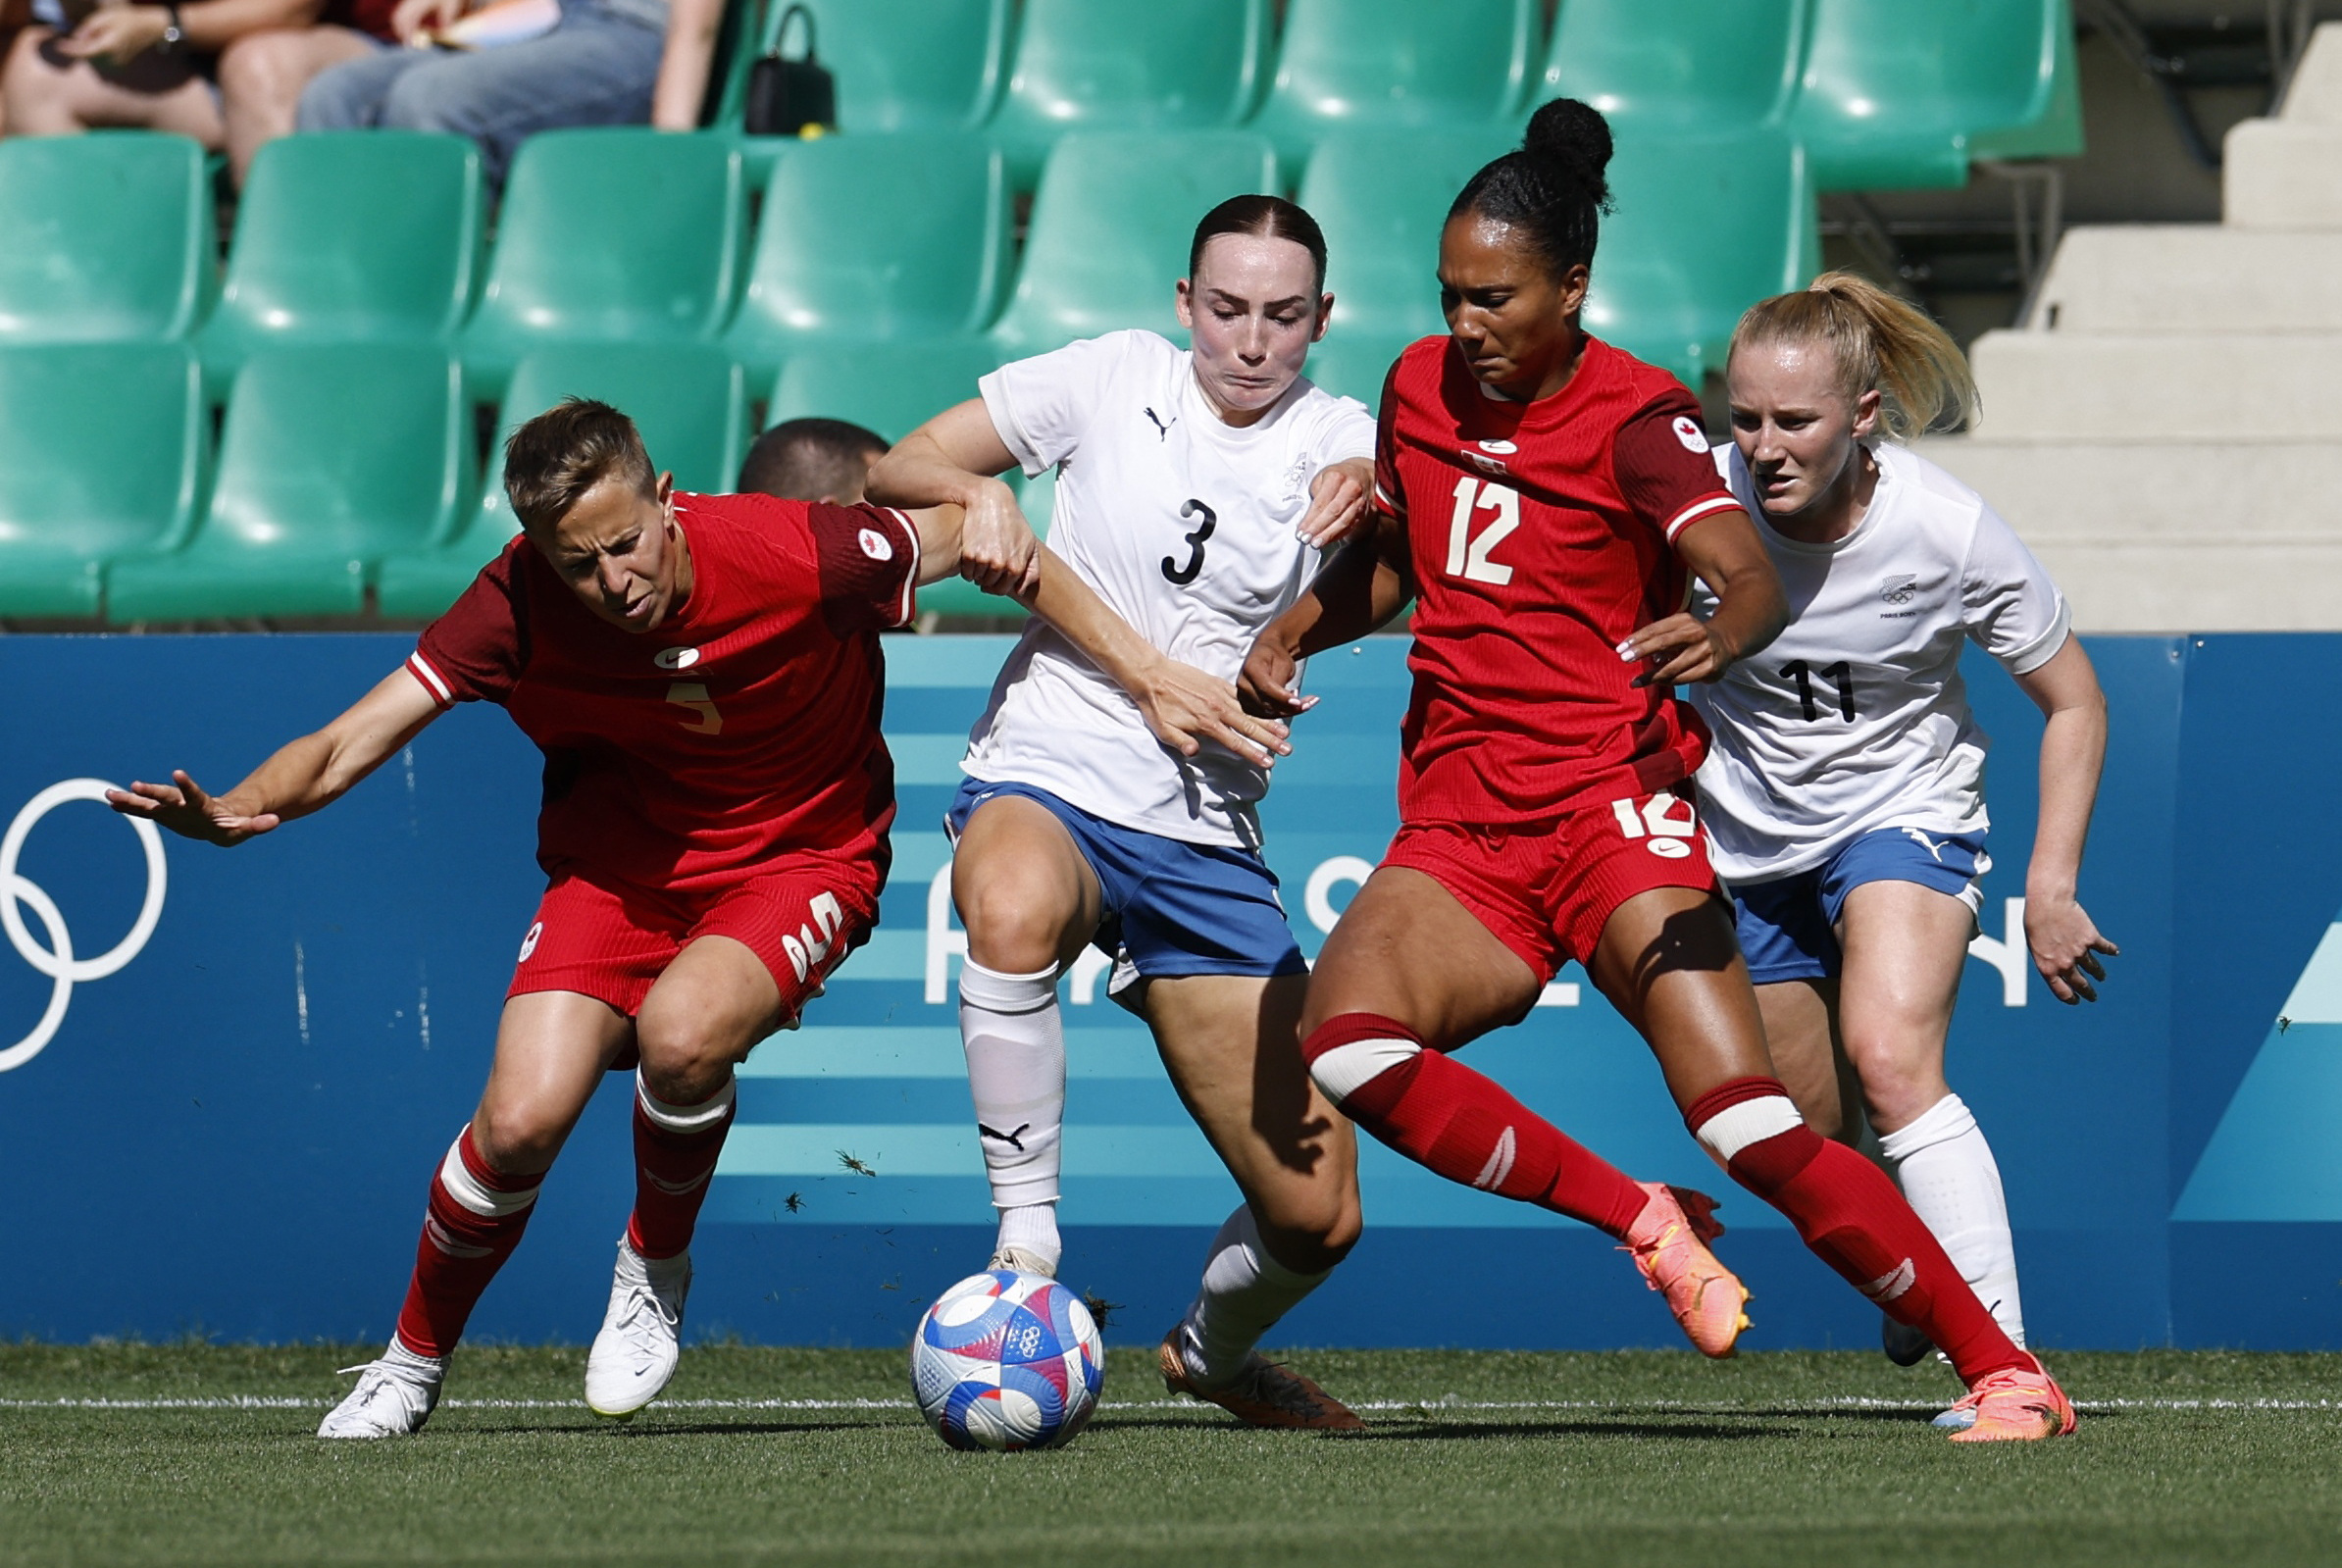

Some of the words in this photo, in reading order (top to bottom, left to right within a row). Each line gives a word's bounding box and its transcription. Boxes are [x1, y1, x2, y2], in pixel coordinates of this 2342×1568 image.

[1161, 499, 1217, 584] 3
[1446, 477, 1519, 585] 12
[666, 683, 723, 735] 5
[1779, 660, 1856, 723] 11
[799, 890, 842, 966] 5
